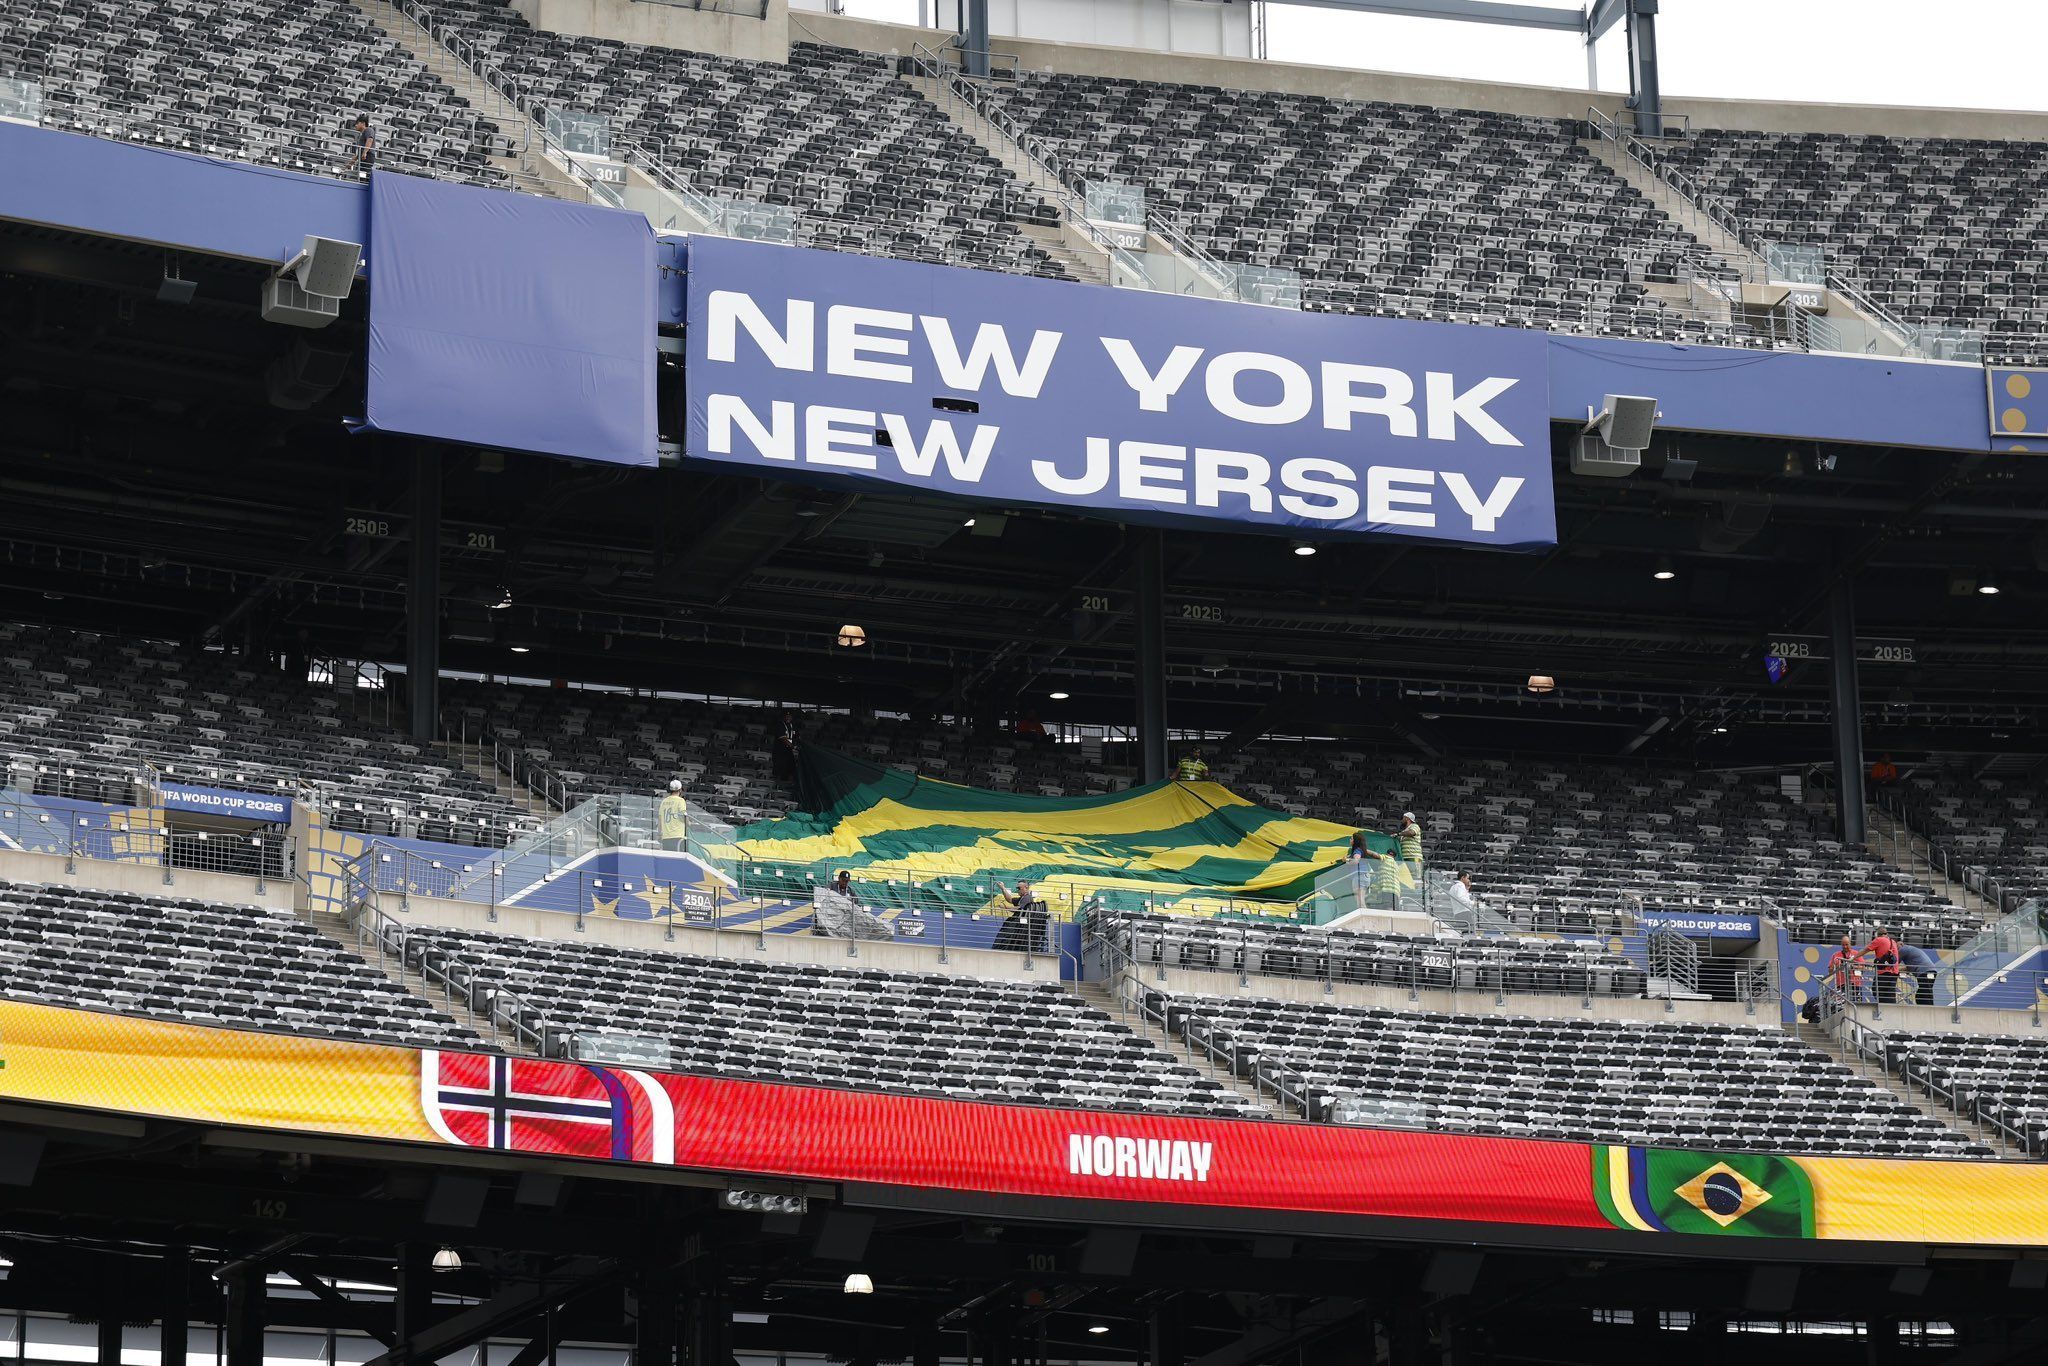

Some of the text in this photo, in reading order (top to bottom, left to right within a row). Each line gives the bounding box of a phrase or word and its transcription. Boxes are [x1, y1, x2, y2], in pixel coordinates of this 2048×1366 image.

[596, 168, 620, 181] 301
[1118, 234, 1140, 248] 302
[1795, 293, 1818, 307] 303
[707, 290, 1524, 447] NEW YORK
[707, 393, 1525, 533] NEW JERSEY
[346, 518, 389, 536] 250B
[467, 533, 495, 549] 201
[1082, 596, 1109, 611] 201
[1182, 605, 1222, 621] 202B
[1770, 642, 1809, 657] 202B
[1874, 646, 1913, 661] 203B
[182, 792, 221, 805] WORLD
[222, 797, 244, 807] CUP
[245, 800, 284, 812] 2026
[684, 894, 711, 907] 250A
[1697, 920, 1717, 930] CUP
[1718, 922, 1752, 931] 2026
[1423, 955, 1450, 967] 202A
[1069, 1134, 1212, 1181] NORWAY
[252, 1199, 287, 1219] 149
[1027, 1254, 1056, 1271] 101
